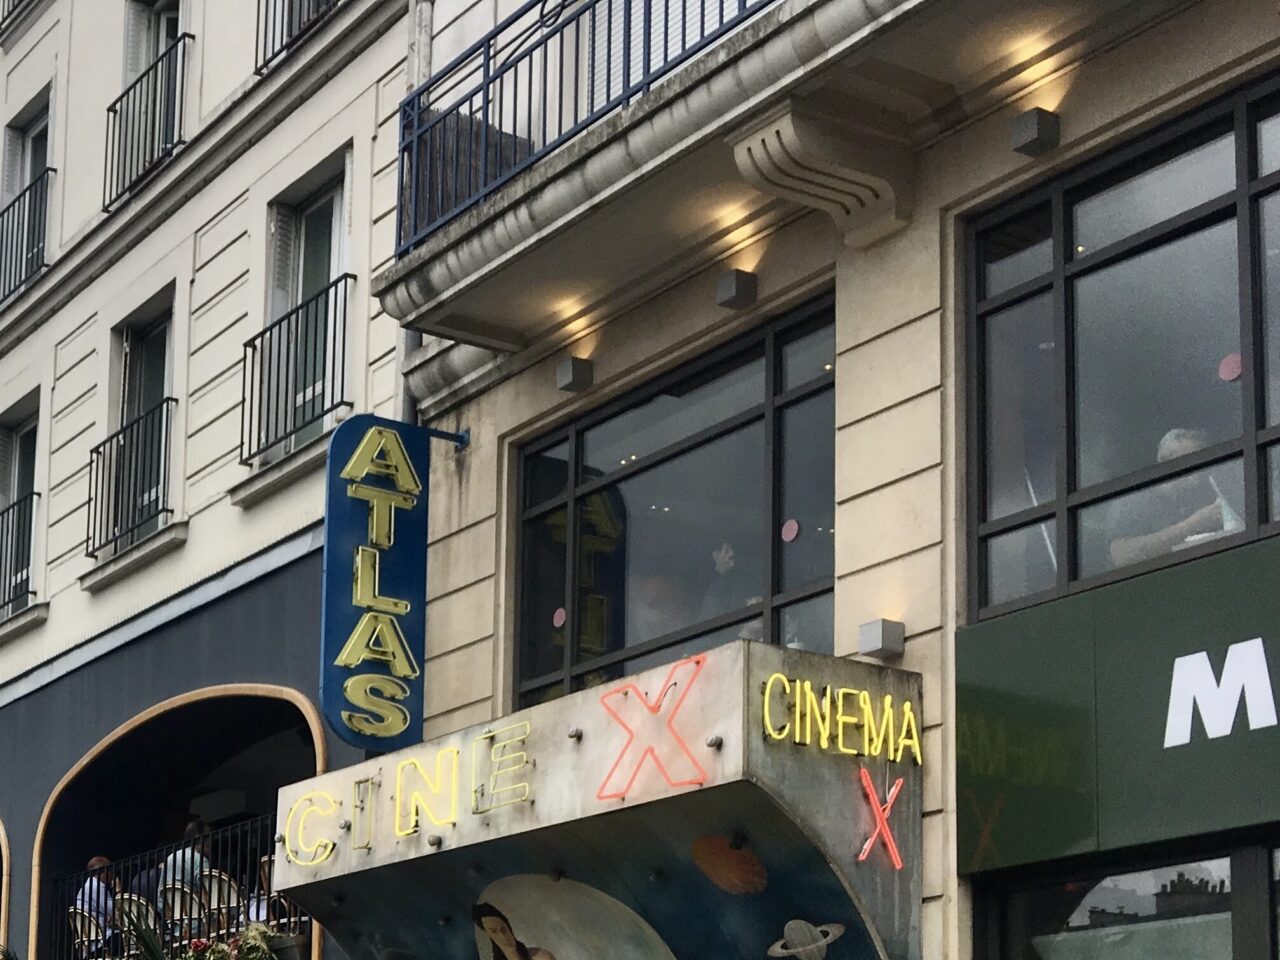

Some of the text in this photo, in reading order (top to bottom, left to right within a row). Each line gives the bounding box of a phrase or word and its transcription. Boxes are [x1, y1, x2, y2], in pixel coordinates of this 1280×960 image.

[334, 426, 422, 738] ATLAS
[764, 673, 922, 765] CINEMA
[1163, 637, 1278, 748] M
[286, 654, 708, 866] CINE X
[858, 768, 904, 869] X
